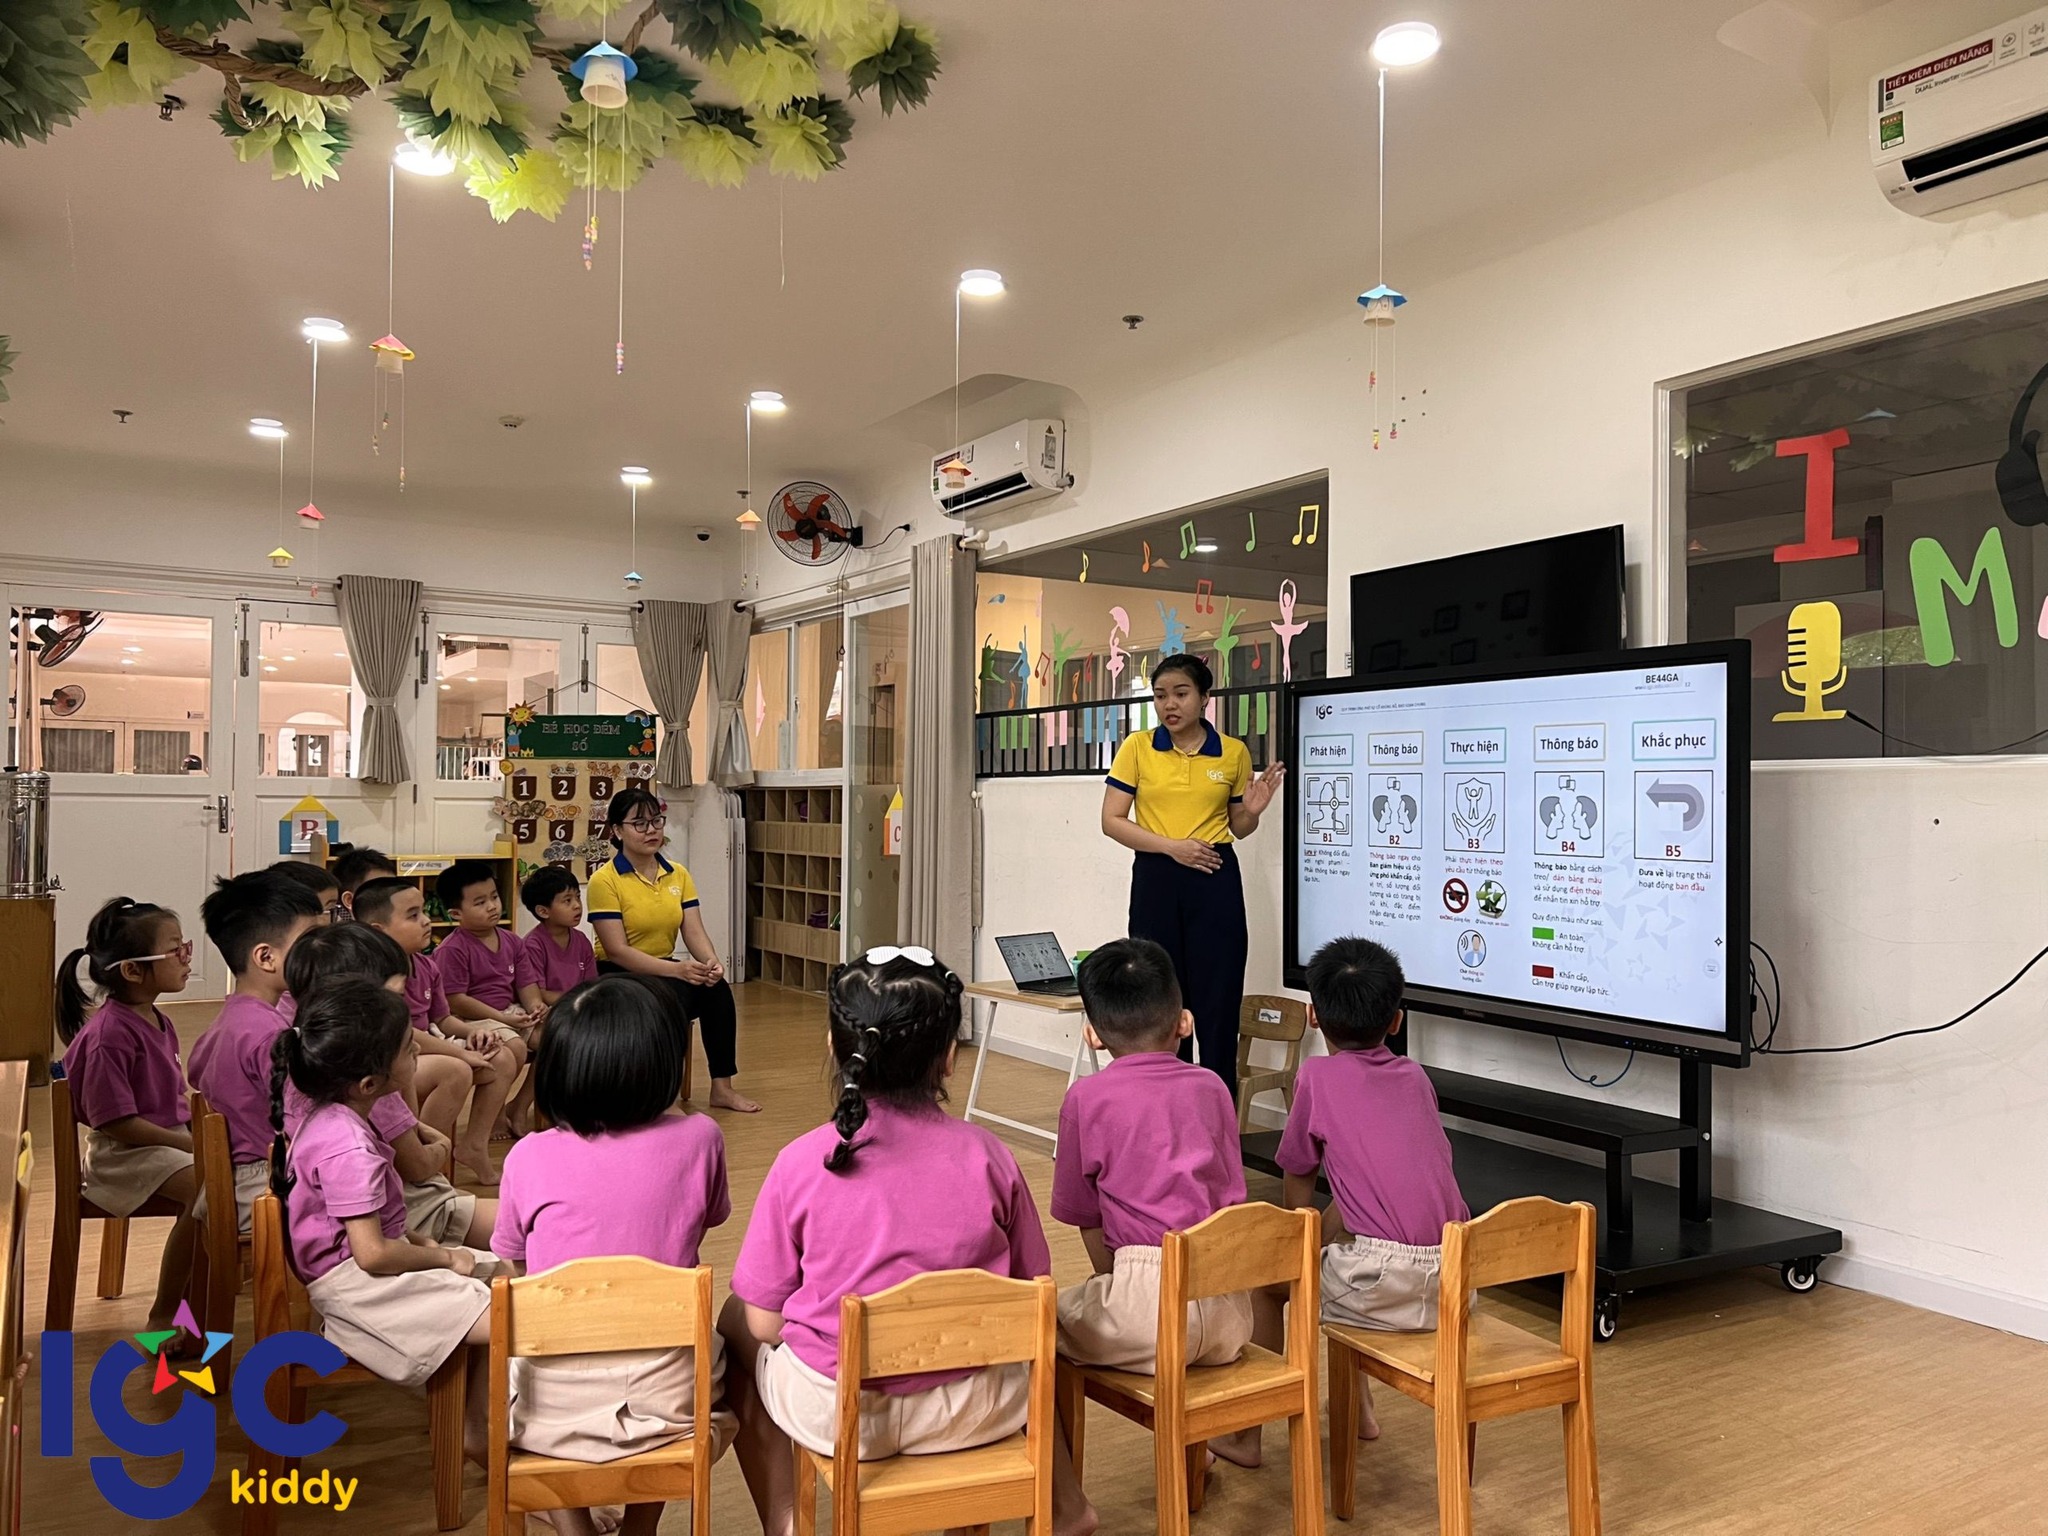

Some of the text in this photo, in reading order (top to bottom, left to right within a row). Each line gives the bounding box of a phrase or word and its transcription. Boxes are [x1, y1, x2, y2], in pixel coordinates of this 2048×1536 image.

[1646, 673, 1679, 683] BE44GA
[542, 720, 620, 736] BÉ HỌC ĐẾM
[572, 737, 588, 751] SỐ
[1540, 737, 1598, 752] Thông báo
[1641, 733, 1706, 749] Khắc phục
[1310, 746, 1346, 757] Phát hiện
[1373, 743, 1418, 756] Thông báo
[1451, 740, 1499, 755] Thực hiện
[519, 780, 606, 796] 1 2 3
[519, 824, 605, 839] 5 6 7
[894, 826, 901, 842] C
[1323, 833, 1332, 842] B1
[1389, 835, 1400, 845] B2
[1468, 838, 1480, 849] B3
[1561, 841, 1575, 852] B4
[1666, 845, 1681, 857] B5
[1474, 868, 1490, 876] thông
[1534, 862, 1553, 871] Thông
[1570, 863, 1585, 873] bằng
[1534, 873, 1549, 881] treo/
[1568, 875, 1584, 884] bảng
[1588, 876, 1602, 884] màu
[1639, 868, 1653, 876] Đưa
[1655, 868, 1664, 876] về
[1666, 870, 1674, 878] lại
[1676, 871, 1695, 880] trạng
[1552, 885, 1568, 894] dụng
[1569, 886, 1583, 894] điện
[1586, 888, 1602, 896] thoại
[1639, 880, 1705, 891] hoạt động ban đầu
[1532, 913, 1544, 922] Quy
[1546, 914, 1559, 922] định
[1532, 941, 1551, 951] Không
[1553, 942, 1564, 951] cần
[1560, 971, 1575, 979] Khẩn
[1556, 982, 1569, 990] giúp
[1570, 985, 1585, 993] ngay
[1586, 985, 1596, 994] lập
